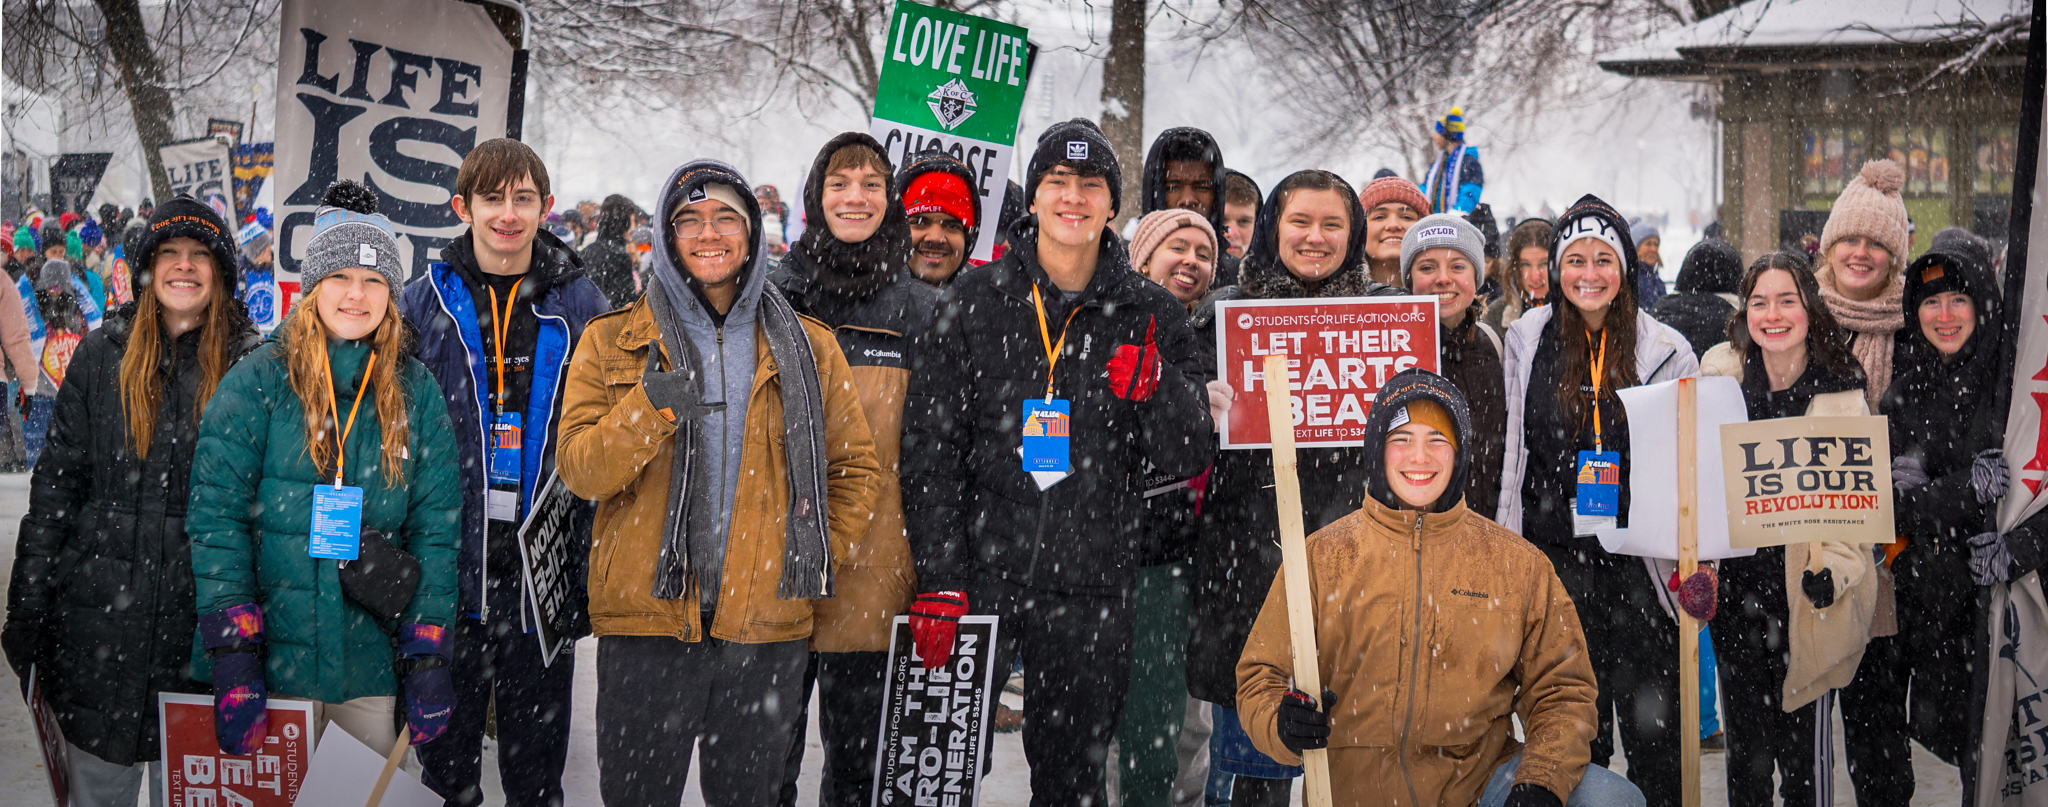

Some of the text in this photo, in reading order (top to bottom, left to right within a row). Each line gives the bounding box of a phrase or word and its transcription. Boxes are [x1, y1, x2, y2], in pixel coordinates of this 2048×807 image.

[893, 12, 1022, 87] LOVE LIFE
[296, 27, 482, 118] LIFE
[943, 87, 950, 96] K
[960, 91, 967, 100] C
[283, 92, 477, 228] IS
[168, 159, 222, 186] LIFE
[929, 205, 942, 213] LIFE
[151, 219, 170, 232] 2024
[201, 218, 220, 235] March
[1420, 227, 1454, 239] TAYLOR
[1251, 328, 1411, 355] LET THEIR
[870, 349, 901, 358] Columbia
[1401, 384, 1416, 393] Life
[1315, 429, 1333, 437] LIFE
[1335, 428, 1348, 437] TO
[1350, 427, 1365, 436] 534
[1738, 436, 1873, 473] LIFE
[1144, 476, 1154, 487] TO
[1743, 469, 1878, 499] IS OUR
[1744, 494, 1879, 516] REVOLUTION!
[1778, 519, 1801, 528] WHITE
[545, 571, 571, 625] THE
[1459, 589, 1489, 599] Columbia
[423, 710, 443, 720] Columbia
[942, 634, 978, 807] ENERATION
[966, 688, 982, 780] TEXT LIFE TO 53445
[896, 736, 919, 798] AM
[172, 769, 181, 792] TEXT
